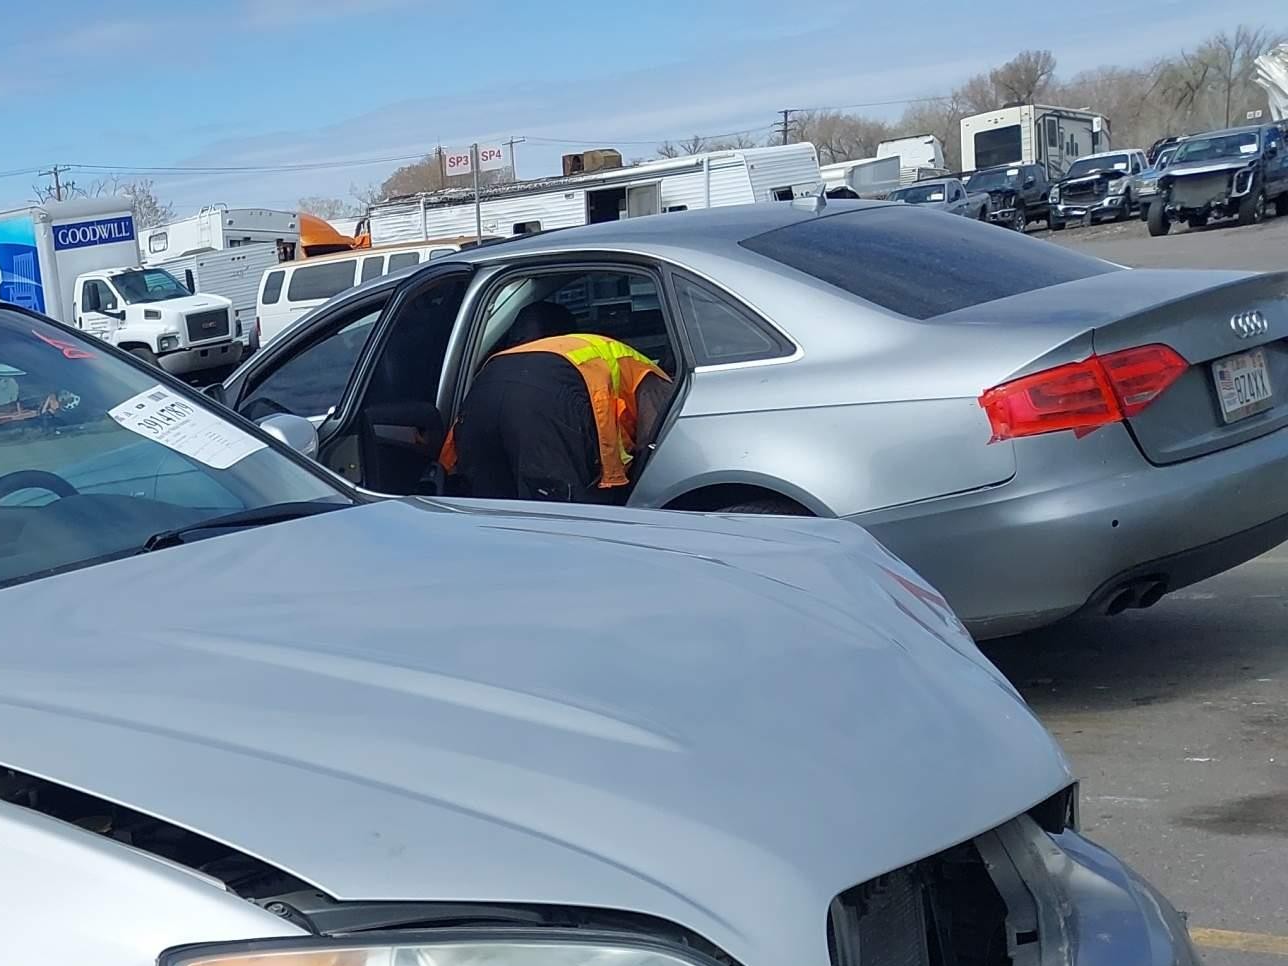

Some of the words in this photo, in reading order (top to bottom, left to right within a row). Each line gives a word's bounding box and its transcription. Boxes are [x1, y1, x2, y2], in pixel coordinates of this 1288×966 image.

[448, 155, 469, 167] SP3
[481, 149, 502, 161] SP4
[58, 222, 130, 245] GOODWILL
[137, 401, 194, 434] 39147879
